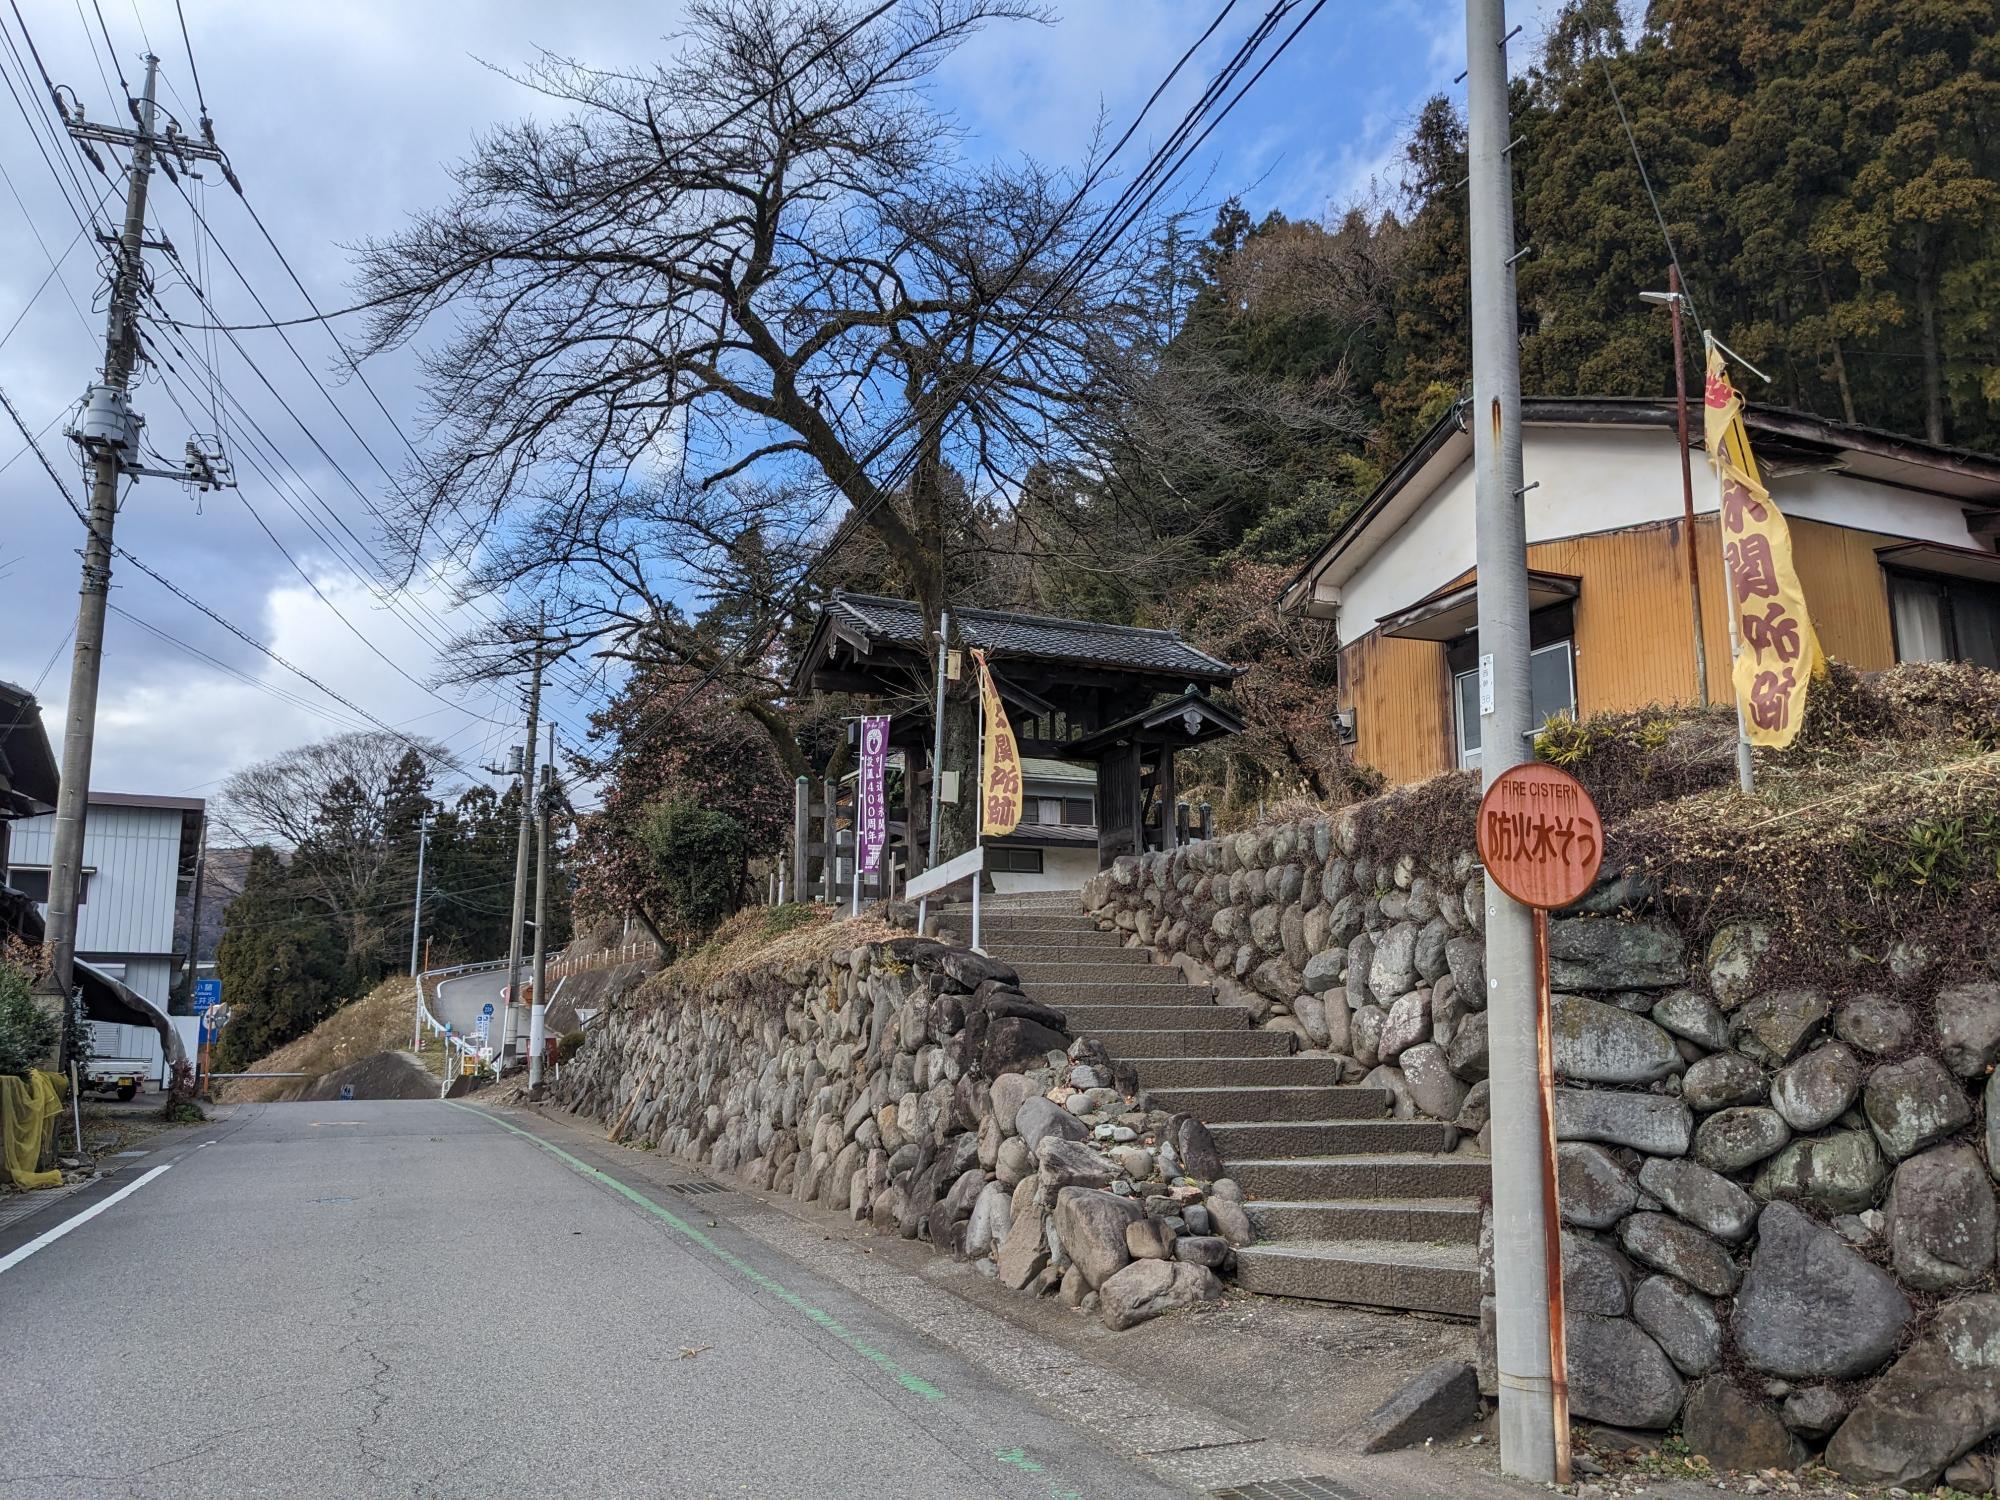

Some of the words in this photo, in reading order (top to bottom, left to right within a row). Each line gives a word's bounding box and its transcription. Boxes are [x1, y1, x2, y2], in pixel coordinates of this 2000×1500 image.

[1502, 781, 1526, 796] FIRE
[1529, 782, 1578, 799] CISTERN
[1488, 811, 1596, 866] 防火水そう
